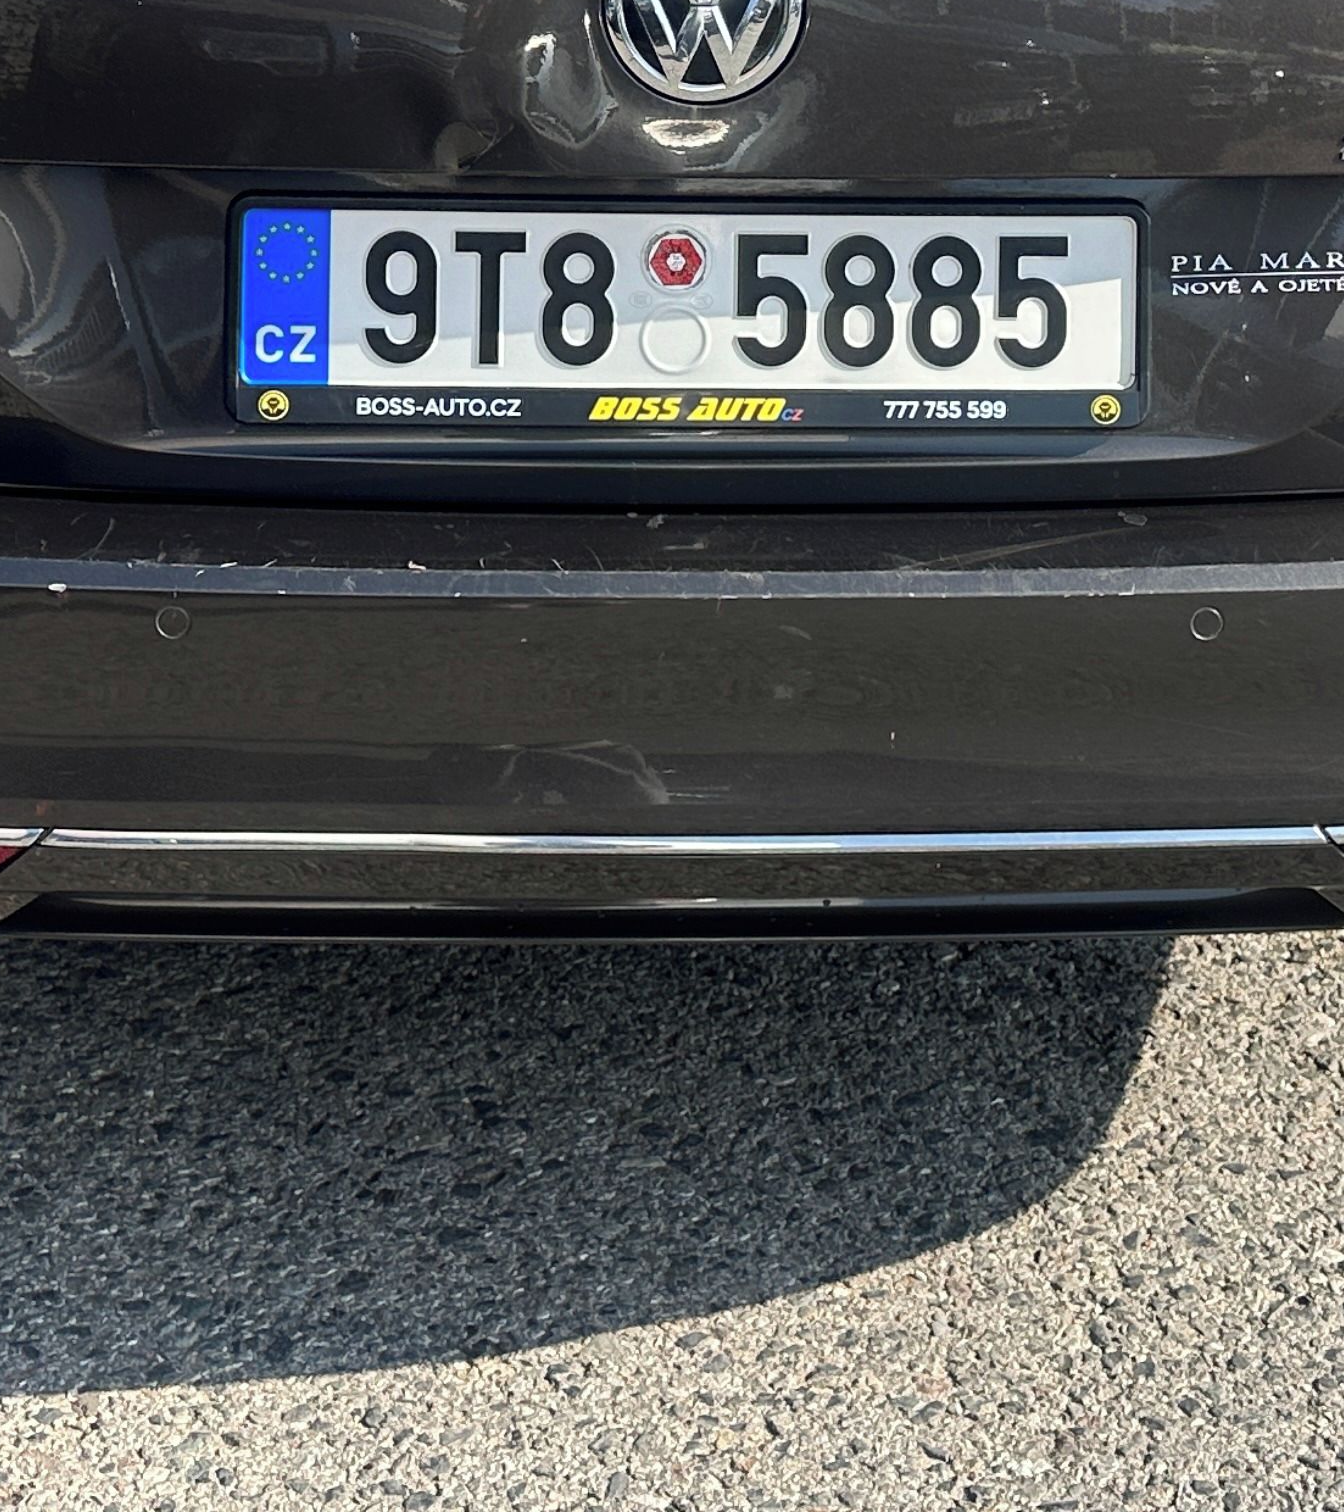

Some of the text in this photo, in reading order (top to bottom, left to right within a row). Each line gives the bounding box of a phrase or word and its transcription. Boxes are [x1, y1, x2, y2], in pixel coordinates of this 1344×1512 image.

[1171, 255, 1233, 272] PIA
[1172, 278, 1242, 296] NOVÉ
[1251, 281, 1268, 294] A
[363, 229, 1070, 368] 9T8 5885
[255, 324, 318, 364] CZ
[355, 397, 522, 417] BOSS-AUTO.CZ
[588, 396, 684, 421] BOSS
[883, 400, 1007, 419] 777 755 599
